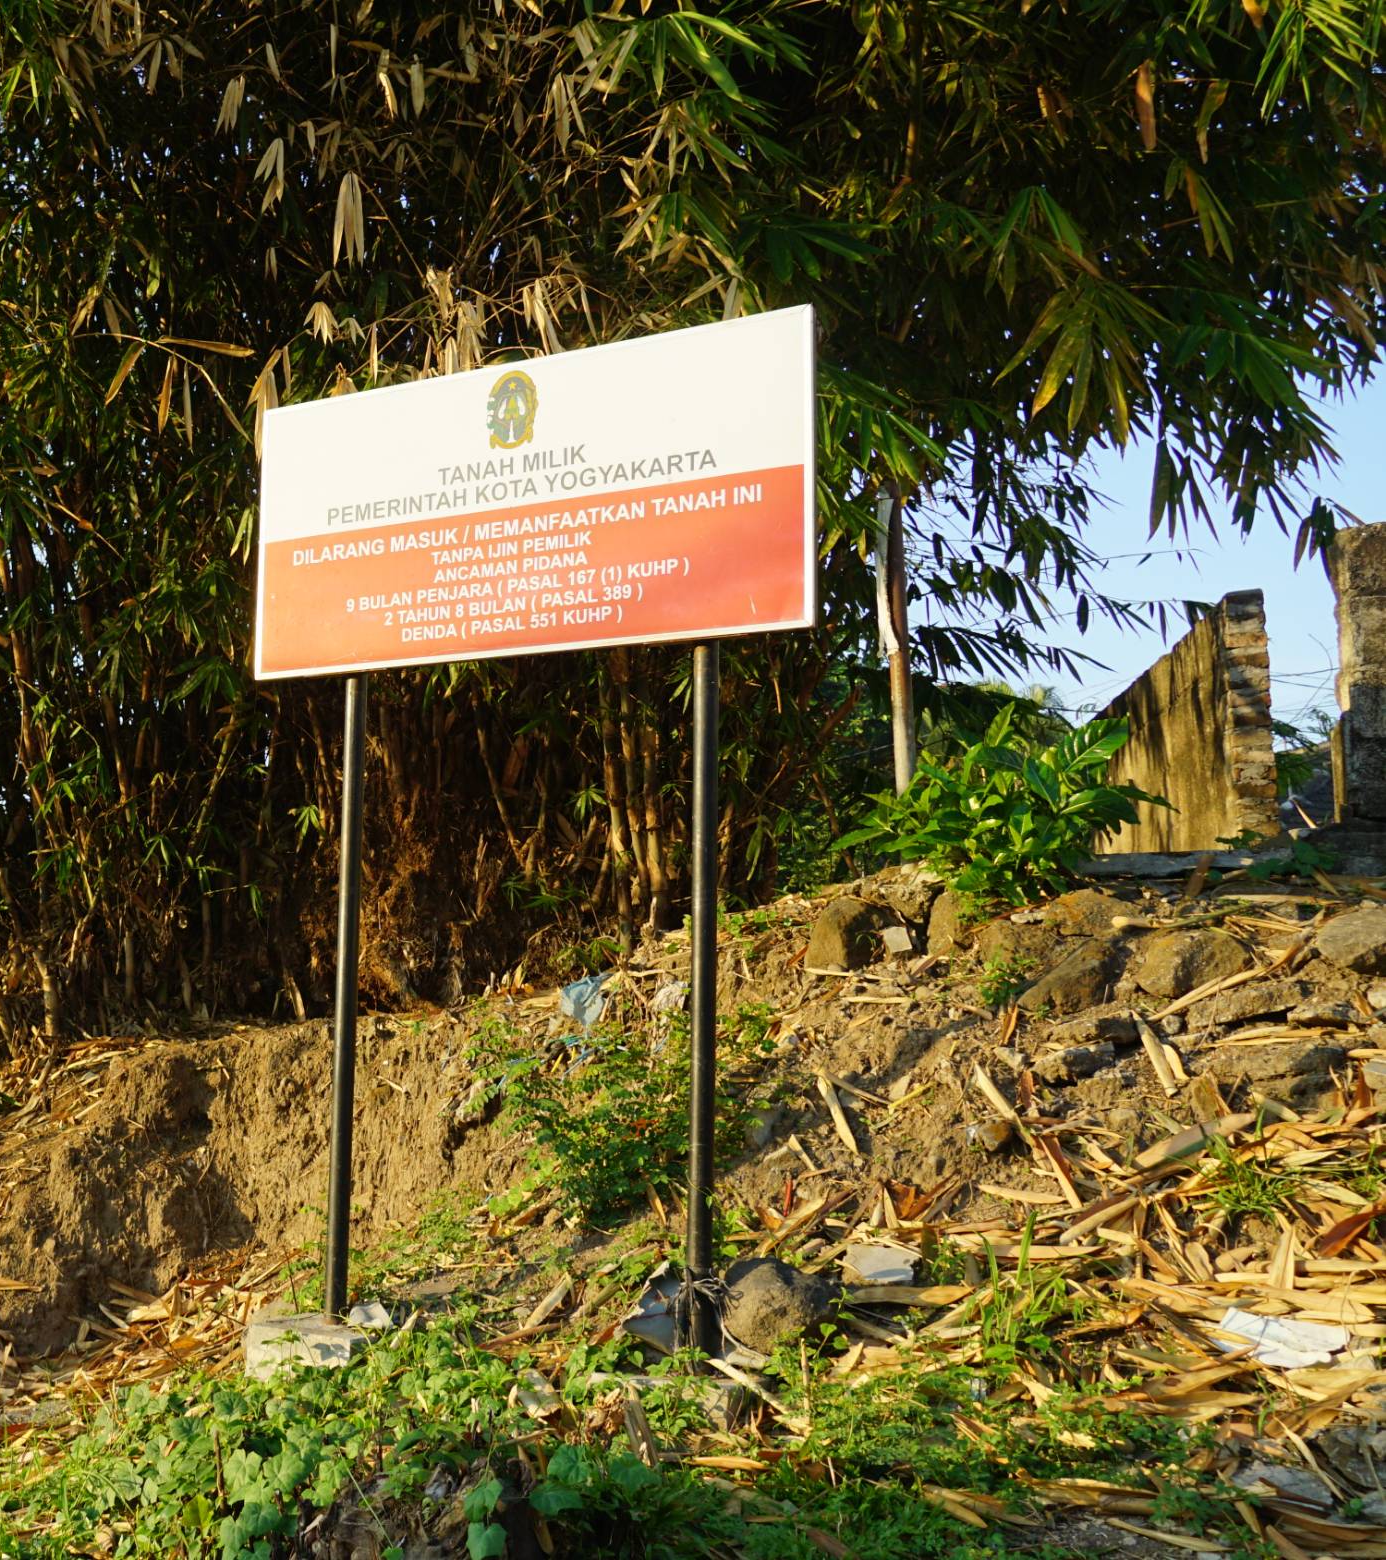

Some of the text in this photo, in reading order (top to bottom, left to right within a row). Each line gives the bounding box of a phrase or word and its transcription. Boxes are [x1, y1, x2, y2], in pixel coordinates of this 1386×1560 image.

[438, 444, 587, 486] TANAH MILIK
[327, 449, 717, 526] PEMERINTAH KOTA YOGYAKARTA
[293, 484, 763, 567] DILARANG MASUK / MEMANFAATKAN TANAH INI
[431, 531, 592, 566] TANPA IJIN PEMILIK
[434, 551, 588, 584] ANCAMAN PIDANA
[346, 557, 690, 612] 9 BULAN PENJARA ( PASAL 167 (1) KUHP )
[383, 583, 643, 626] 2 TAHUN 8 BULAN ( PASAL 389 )
[401, 604, 623, 642] DENDA ( PASAL 551 KUHP )
